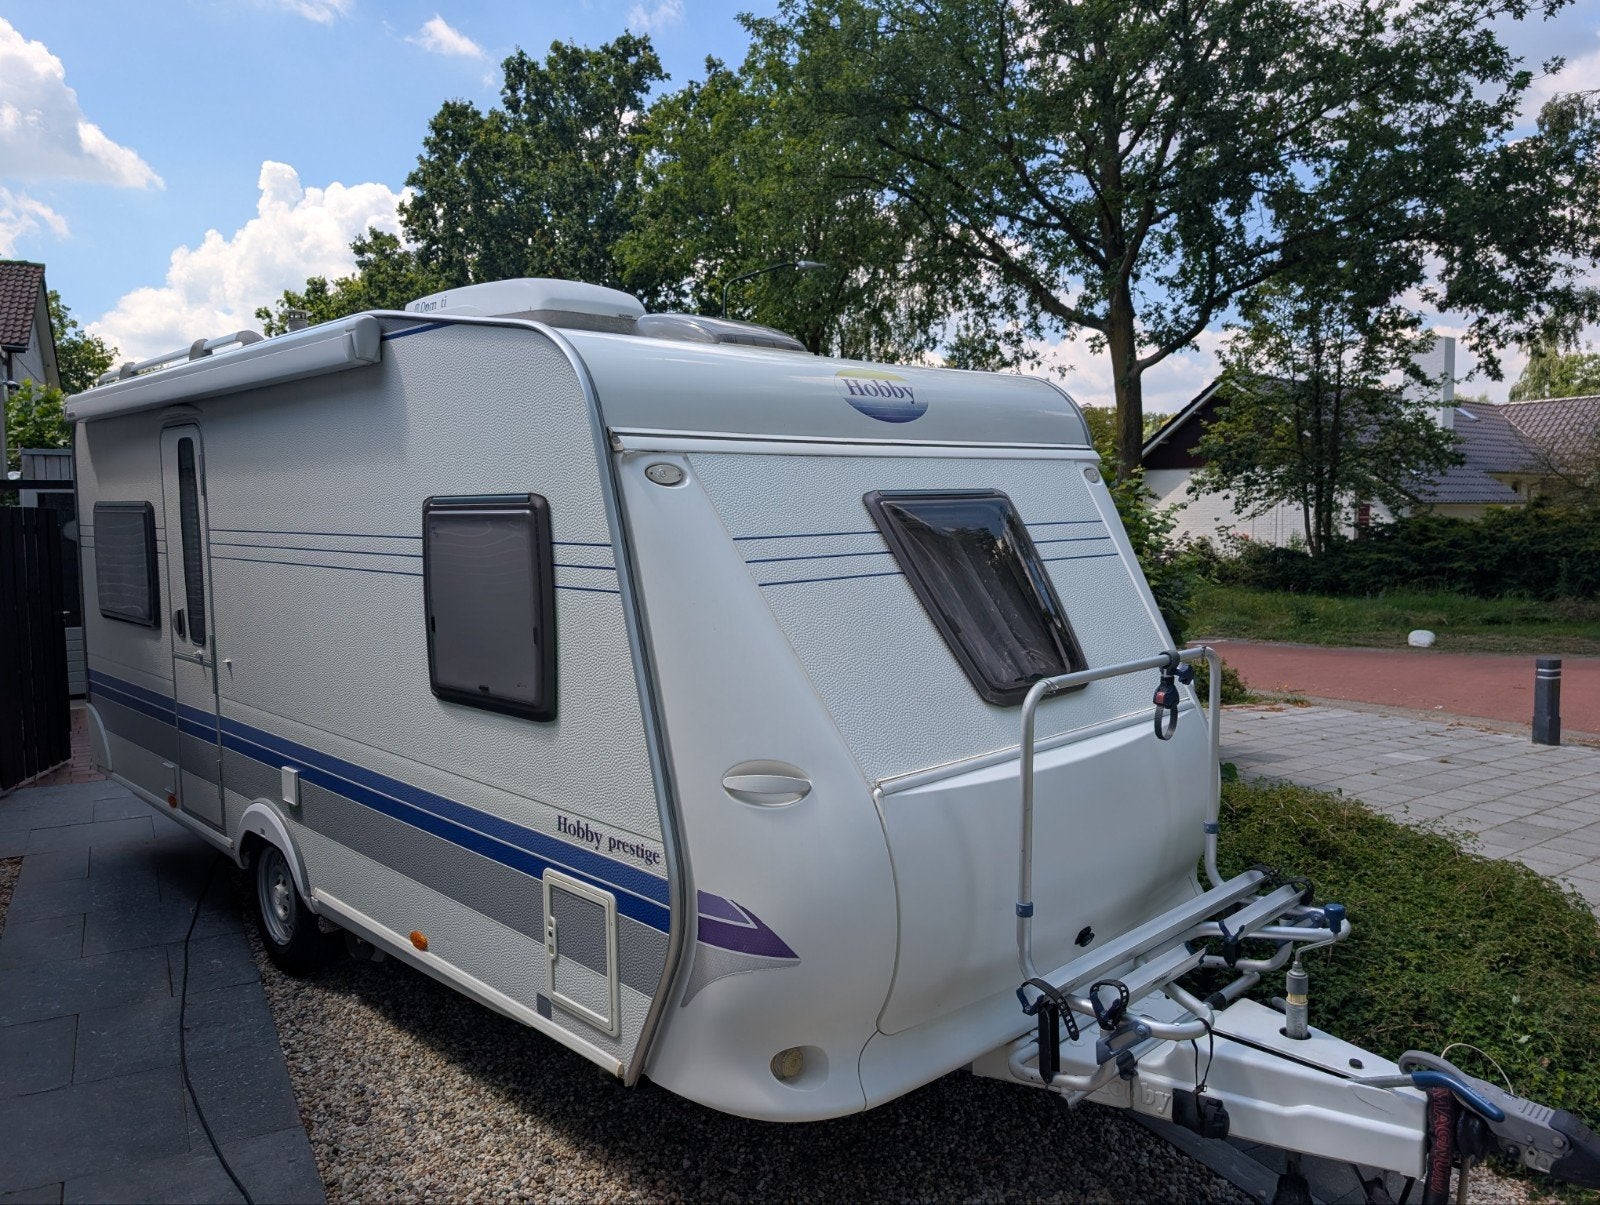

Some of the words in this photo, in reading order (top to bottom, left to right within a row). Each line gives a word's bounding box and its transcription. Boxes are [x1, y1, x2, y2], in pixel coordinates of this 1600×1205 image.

[841, 379, 915, 404] Hobby
[557, 815, 602, 850] Hobby
[608, 836, 660, 865] prestige
